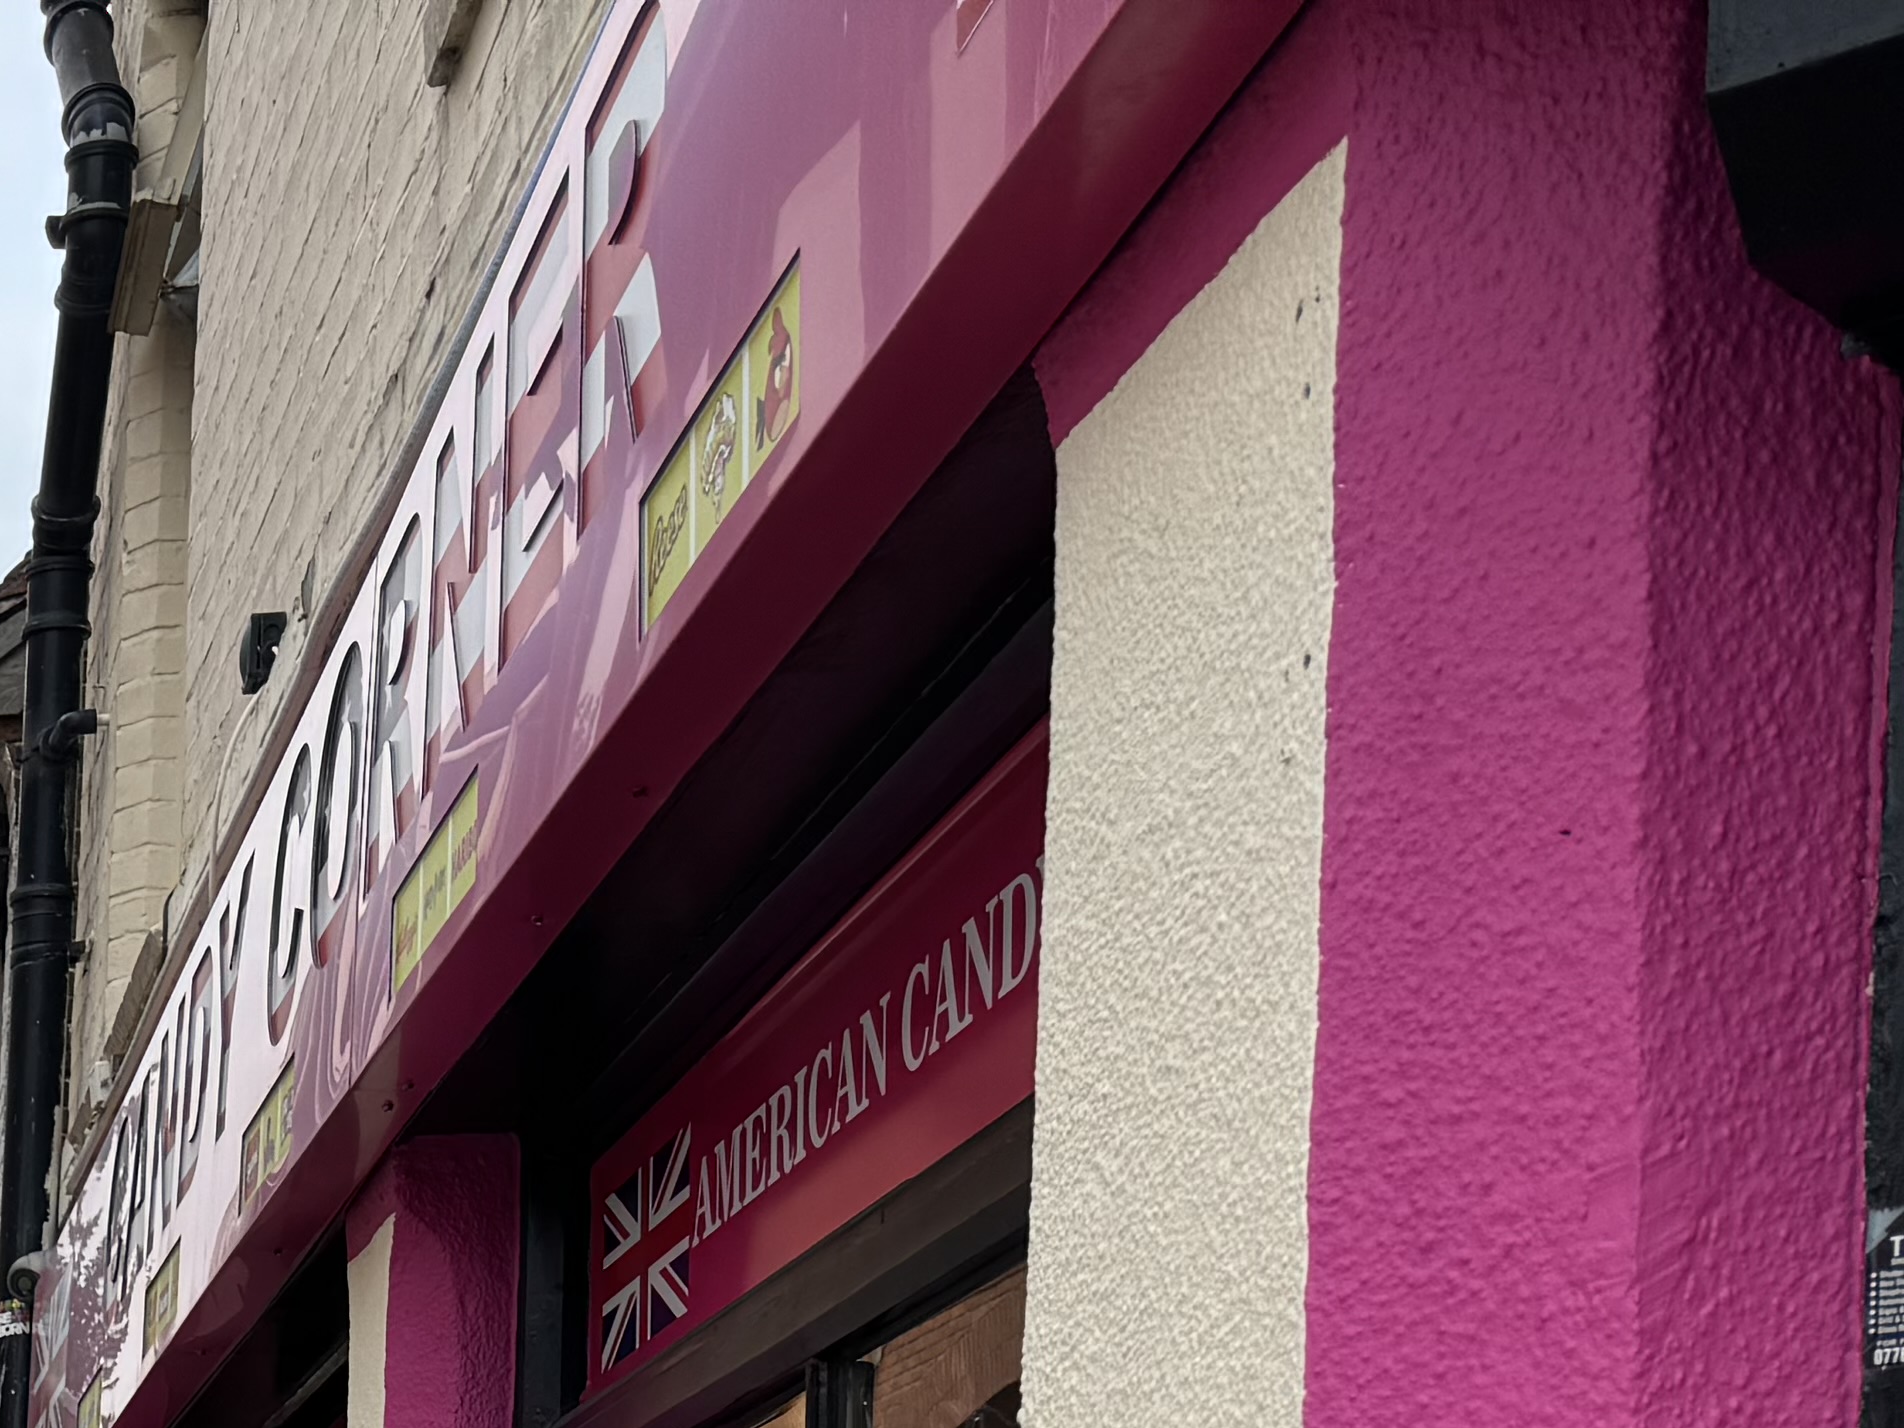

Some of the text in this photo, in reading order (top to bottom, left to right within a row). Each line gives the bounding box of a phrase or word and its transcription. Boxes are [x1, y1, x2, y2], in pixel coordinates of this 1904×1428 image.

[105, 0, 668, 1315] CANDY CORNER
[691, 990, 891, 1247] AMERICAN
